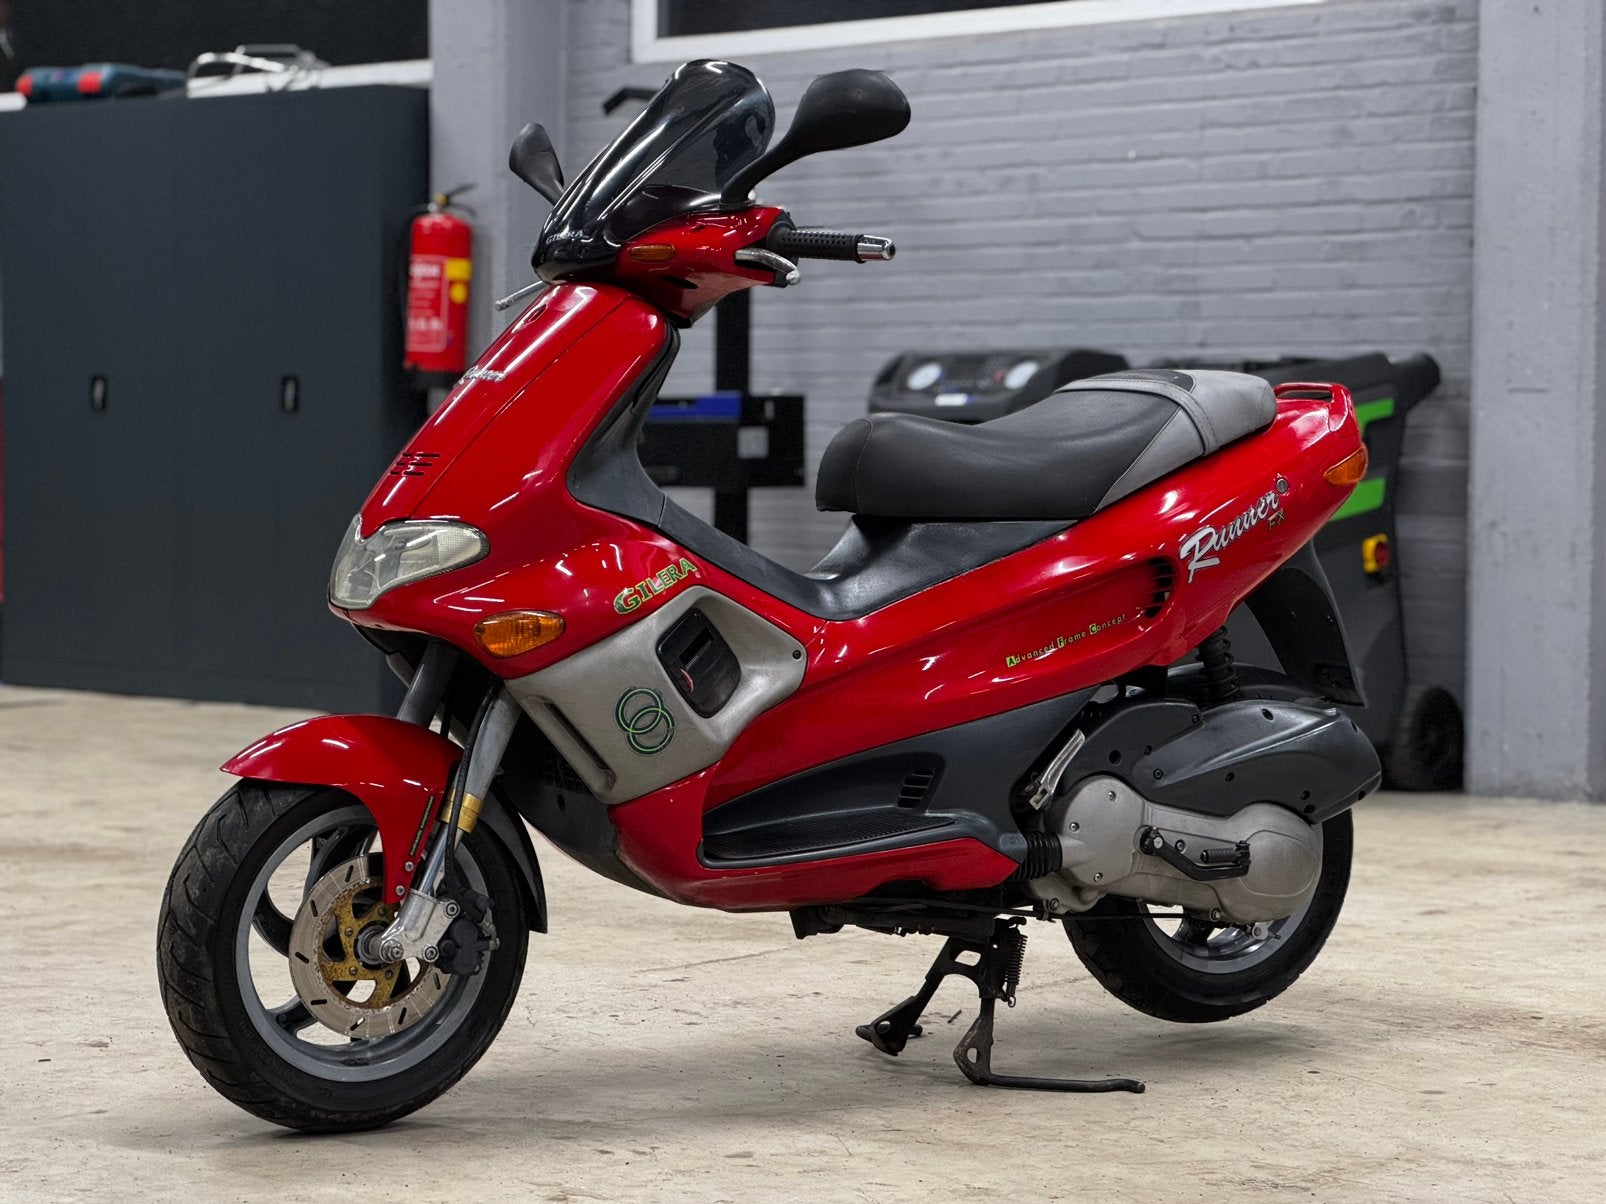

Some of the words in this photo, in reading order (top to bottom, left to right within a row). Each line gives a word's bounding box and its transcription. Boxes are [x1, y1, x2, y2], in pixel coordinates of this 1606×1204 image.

[1179, 490, 1280, 584] Runner
[1267, 508, 1285, 531] FX
[613, 557, 698, 614] GILERA
[1005, 641, 1055, 668] Advanced
[1056, 631, 1087, 649] Frame
[1088, 613, 1126, 636] Concept
